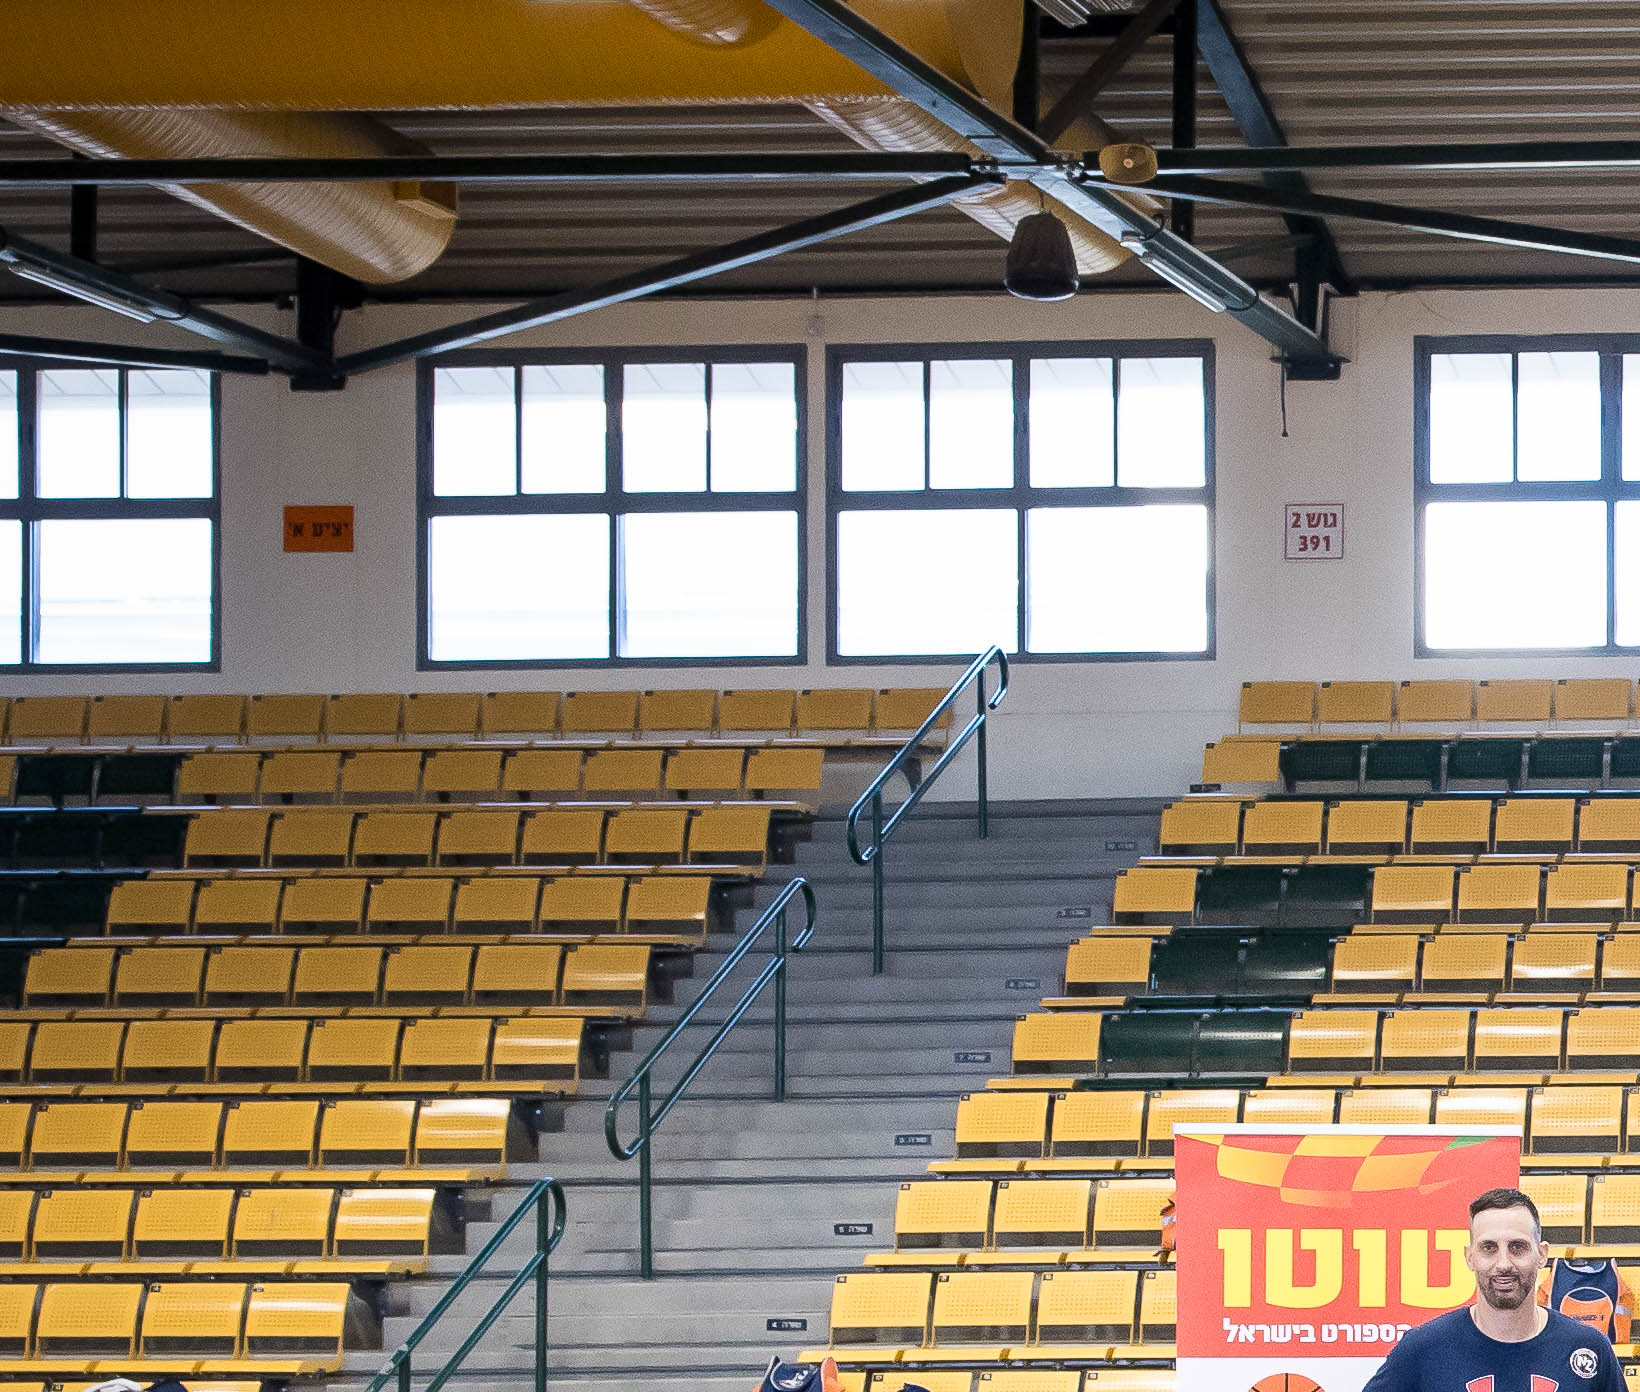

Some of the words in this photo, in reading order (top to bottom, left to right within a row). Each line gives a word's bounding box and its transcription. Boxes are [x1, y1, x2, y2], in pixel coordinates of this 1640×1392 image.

[1291, 512, 1302, 529] 2
[1305, 512, 1338, 529] גוש
[1299, 535, 1331, 552] 391
[1217, 1228, 1477, 1309] טוטו
[1223, 1317, 1316, 1343] בישראל
